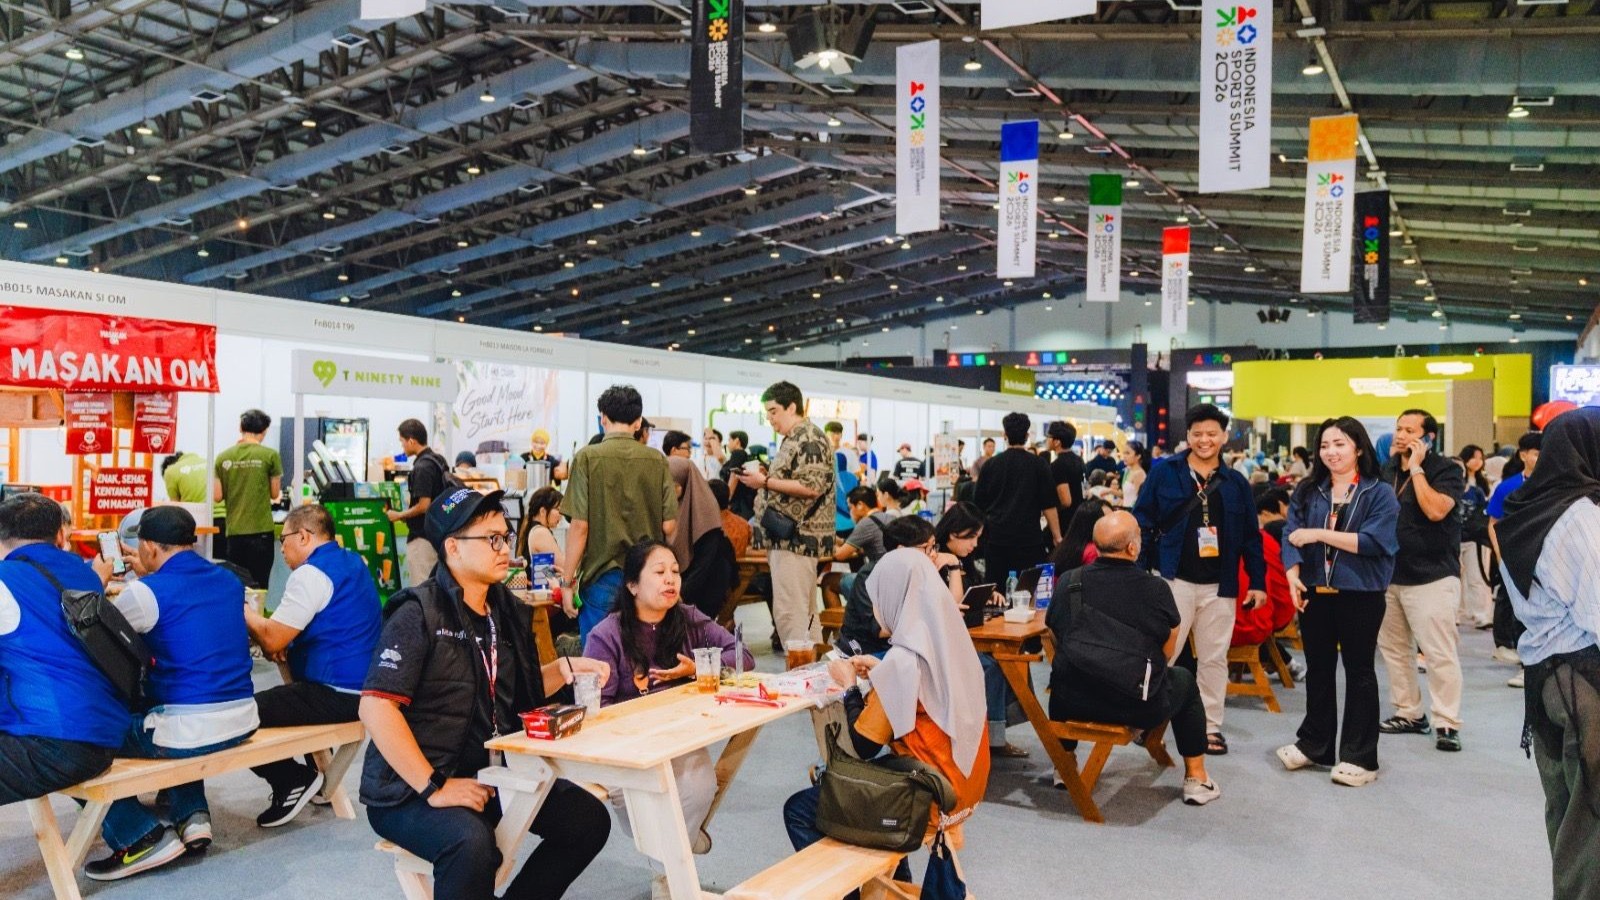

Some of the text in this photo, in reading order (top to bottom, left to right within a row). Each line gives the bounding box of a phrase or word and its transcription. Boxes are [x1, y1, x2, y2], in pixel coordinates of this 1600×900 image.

[1215, 52, 1228, 103] 2026
[1243, 47, 1256, 131] INDONESIA
[1228, 50, 1242, 172] SPORTS SUMMIT
[1006, 197, 1014, 227] 2026
[1021, 196, 1029, 243] INDONESIA
[1314, 201, 1324, 234] 2026
[1332, 200, 1343, 253] INDONESIA
[1321, 201, 1333, 280] SPORTS SUMMIT
[36, 285, 93, 300] MASAKAN
[96, 293, 105, 302] SI
[107, 294, 126, 304] OM
[314, 319, 341, 330] FnB014
[10, 347, 211, 388] MASAKAN OM
[342, 370, 441, 388] T NINETY NINE
[461, 381, 526, 417] Good Mood
[467, 404, 534, 439] Starts Here
